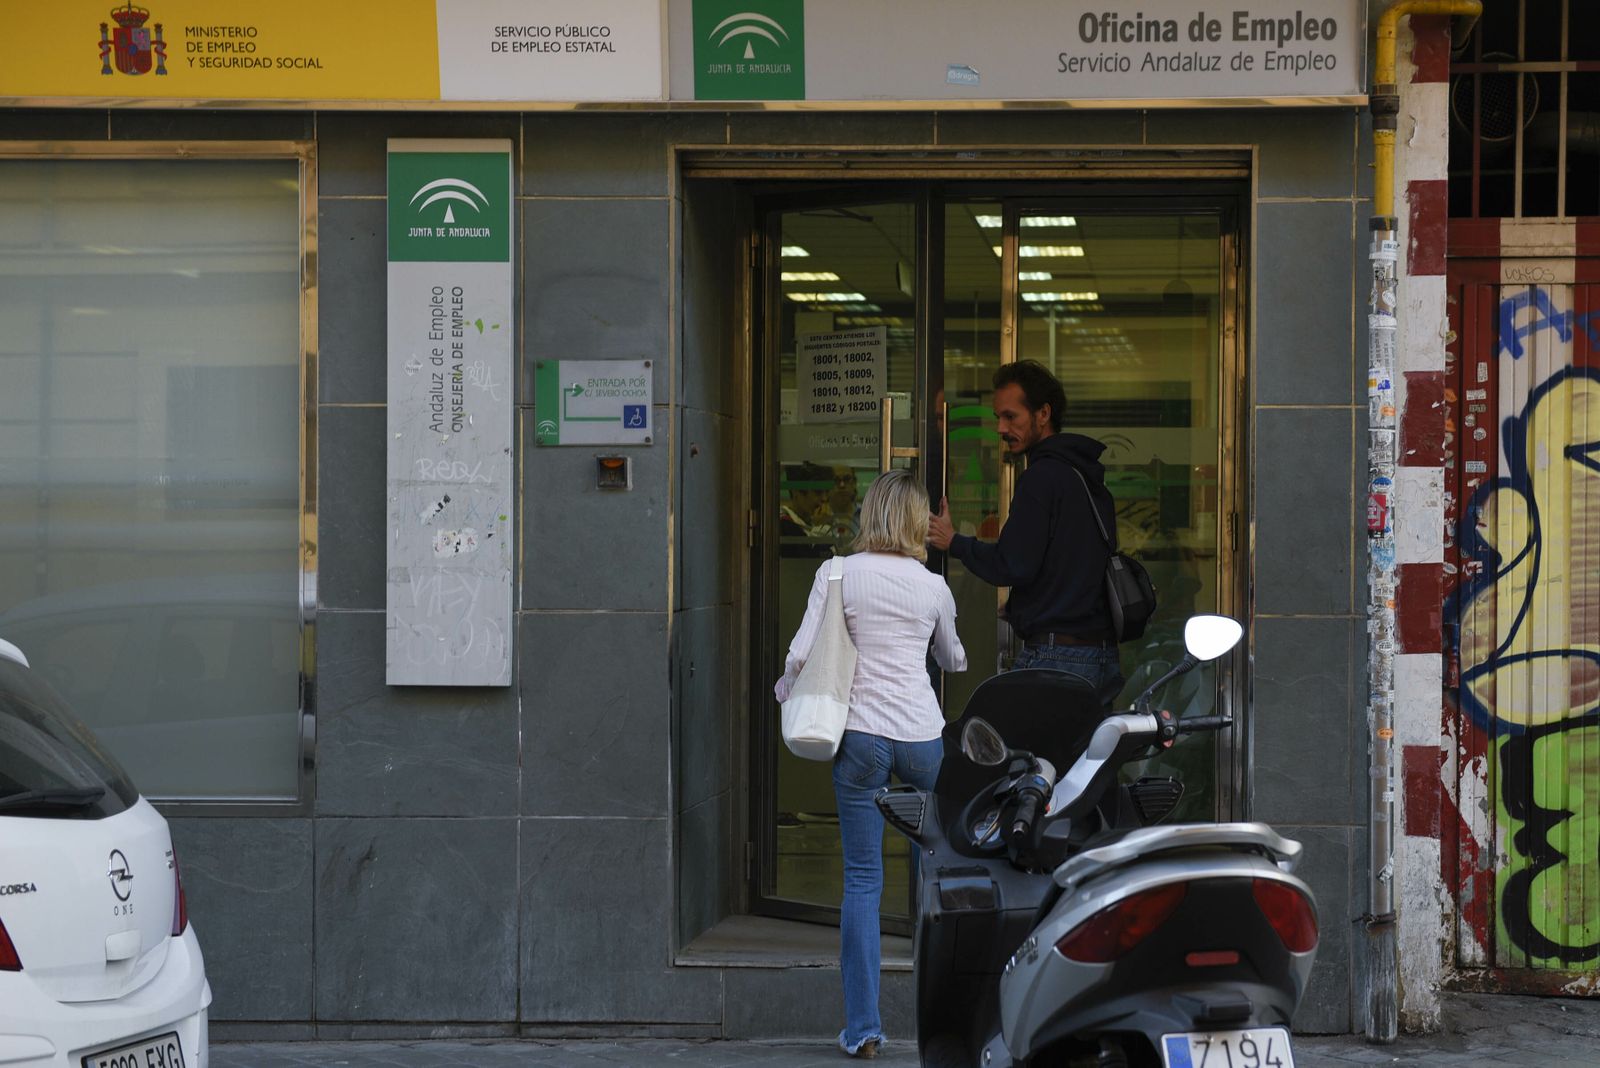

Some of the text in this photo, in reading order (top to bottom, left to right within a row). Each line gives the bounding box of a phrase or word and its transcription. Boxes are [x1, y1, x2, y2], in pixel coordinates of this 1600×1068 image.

[185, 26, 258, 38] MINISTERIO
[494, 23, 611, 38] SERVICIO PÚBLICO
[1078, 10, 1338, 49] Oficina de Empleo
[186, 41, 257, 53] DE EMPLEO
[491, 41, 617, 53] DE EMPLEO ESTATAL
[187, 56, 324, 69] Y SEGURIDAD SOCIAL
[707, 63, 792, 74] JUNTA DE ANDALUCIA
[1057, 50, 1338, 77] Servicio Andaluz de Empleo
[408, 227, 491, 238] JUNTA DE ANDALUCIA
[451, 286, 464, 338] EMPLEO
[451, 342, 464, 360] DE
[844, 352, 875, 363] 18002,
[428, 285, 448, 434] Andaluz de Empleo
[812, 368, 875, 382] 18005, 18009,
[588, 378, 627, 388] ENTRADA
[584, 389, 593, 399] C/
[622, 389, 648, 398] OCHOA
[844, 385, 875, 396] 18012,
[811, 401, 877, 415] 18182 y 18200
[0, 882, 37, 896] CORSA
[113, 903, 134, 917] ONE
[1193, 1036, 1284, 1068] 7194
